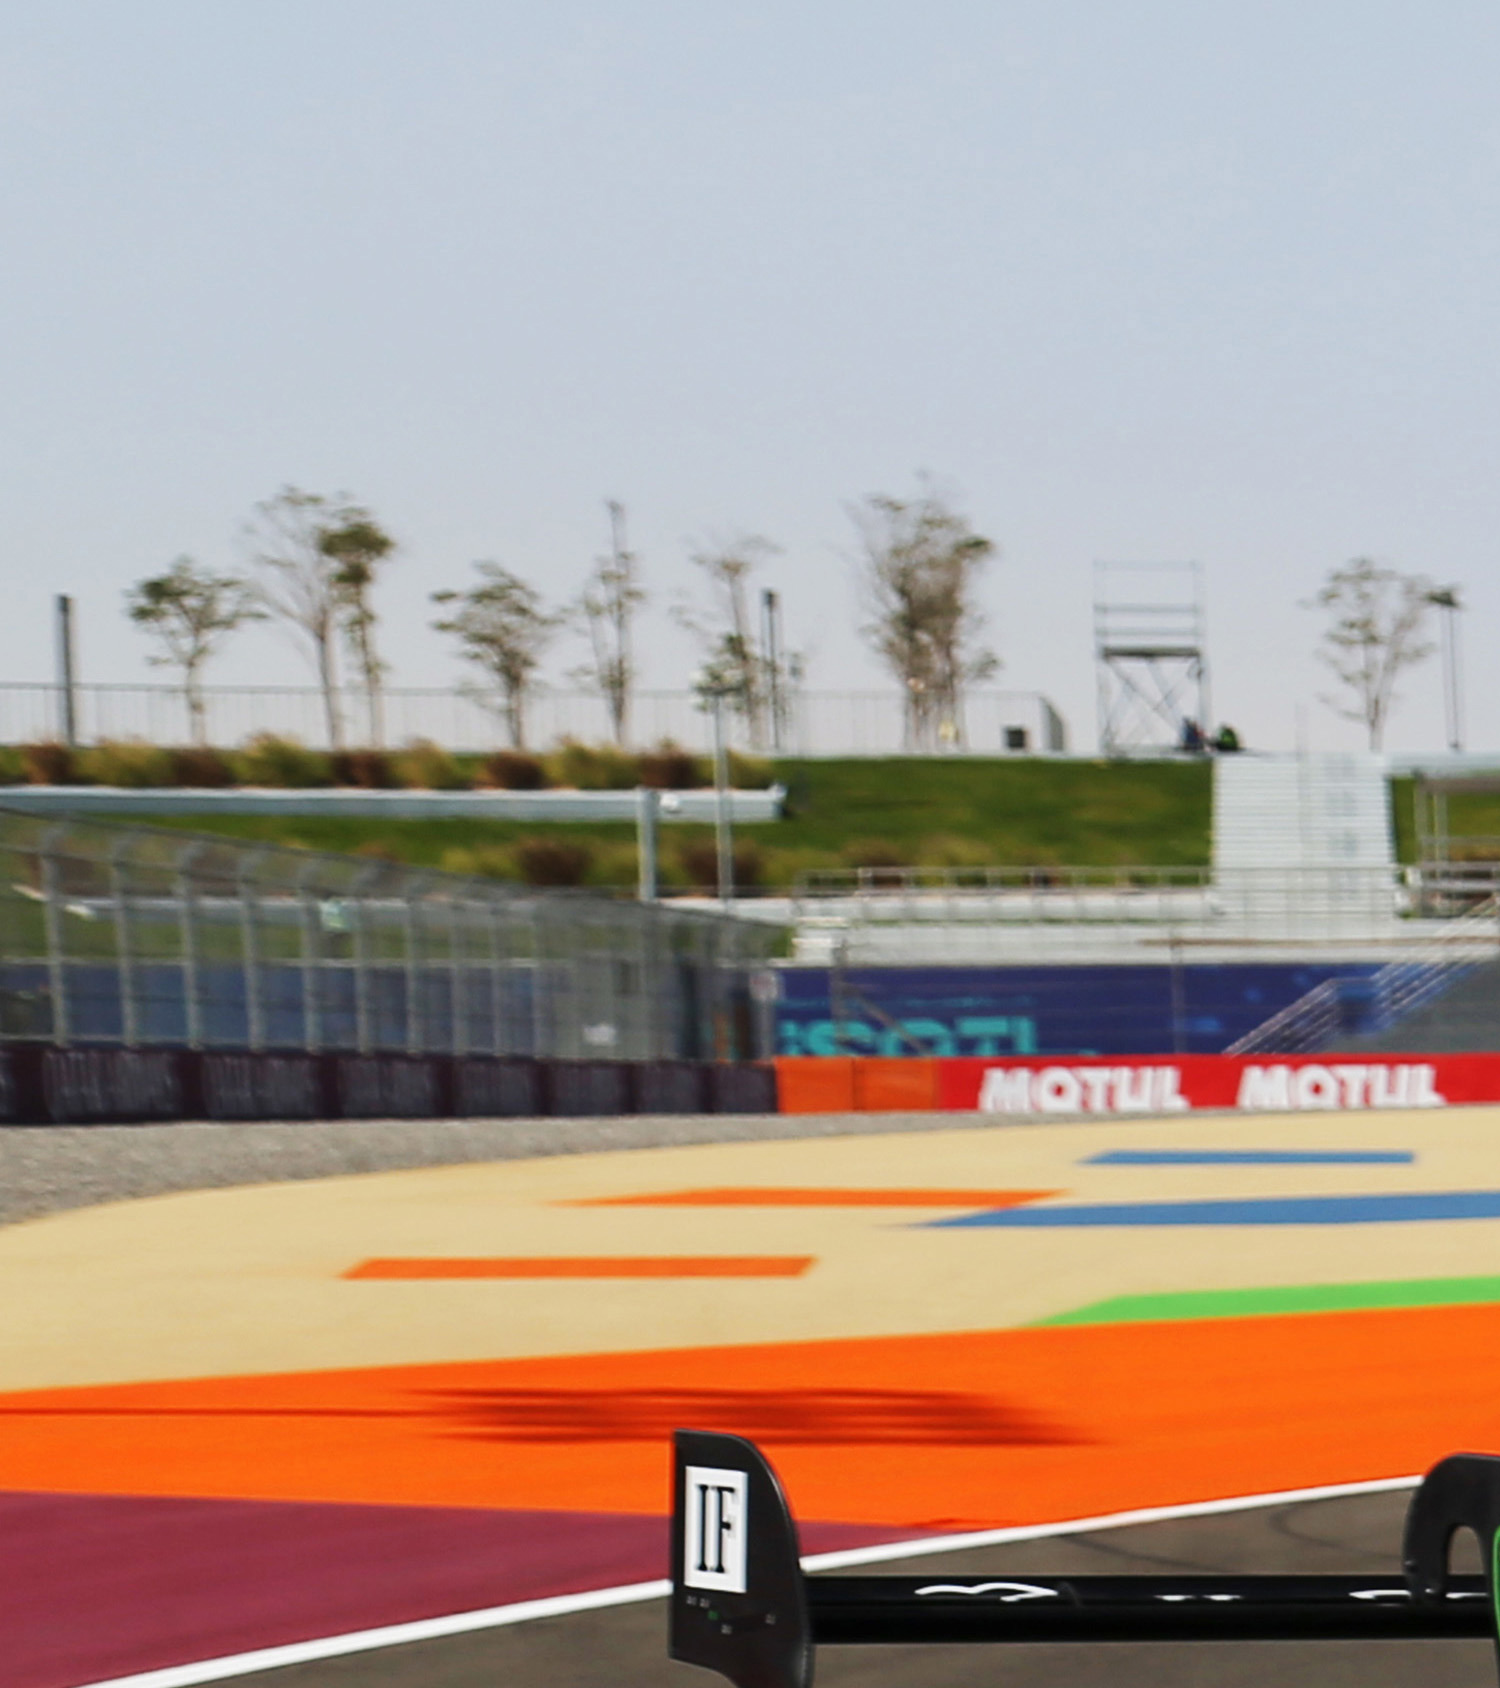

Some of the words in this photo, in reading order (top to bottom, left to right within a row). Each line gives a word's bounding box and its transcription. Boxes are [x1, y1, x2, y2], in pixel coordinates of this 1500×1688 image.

[978, 1066, 1191, 1113] MOTUL
[1235, 1063, 1446, 1109] MOTUL
[695, 1484, 736, 1574] IF
